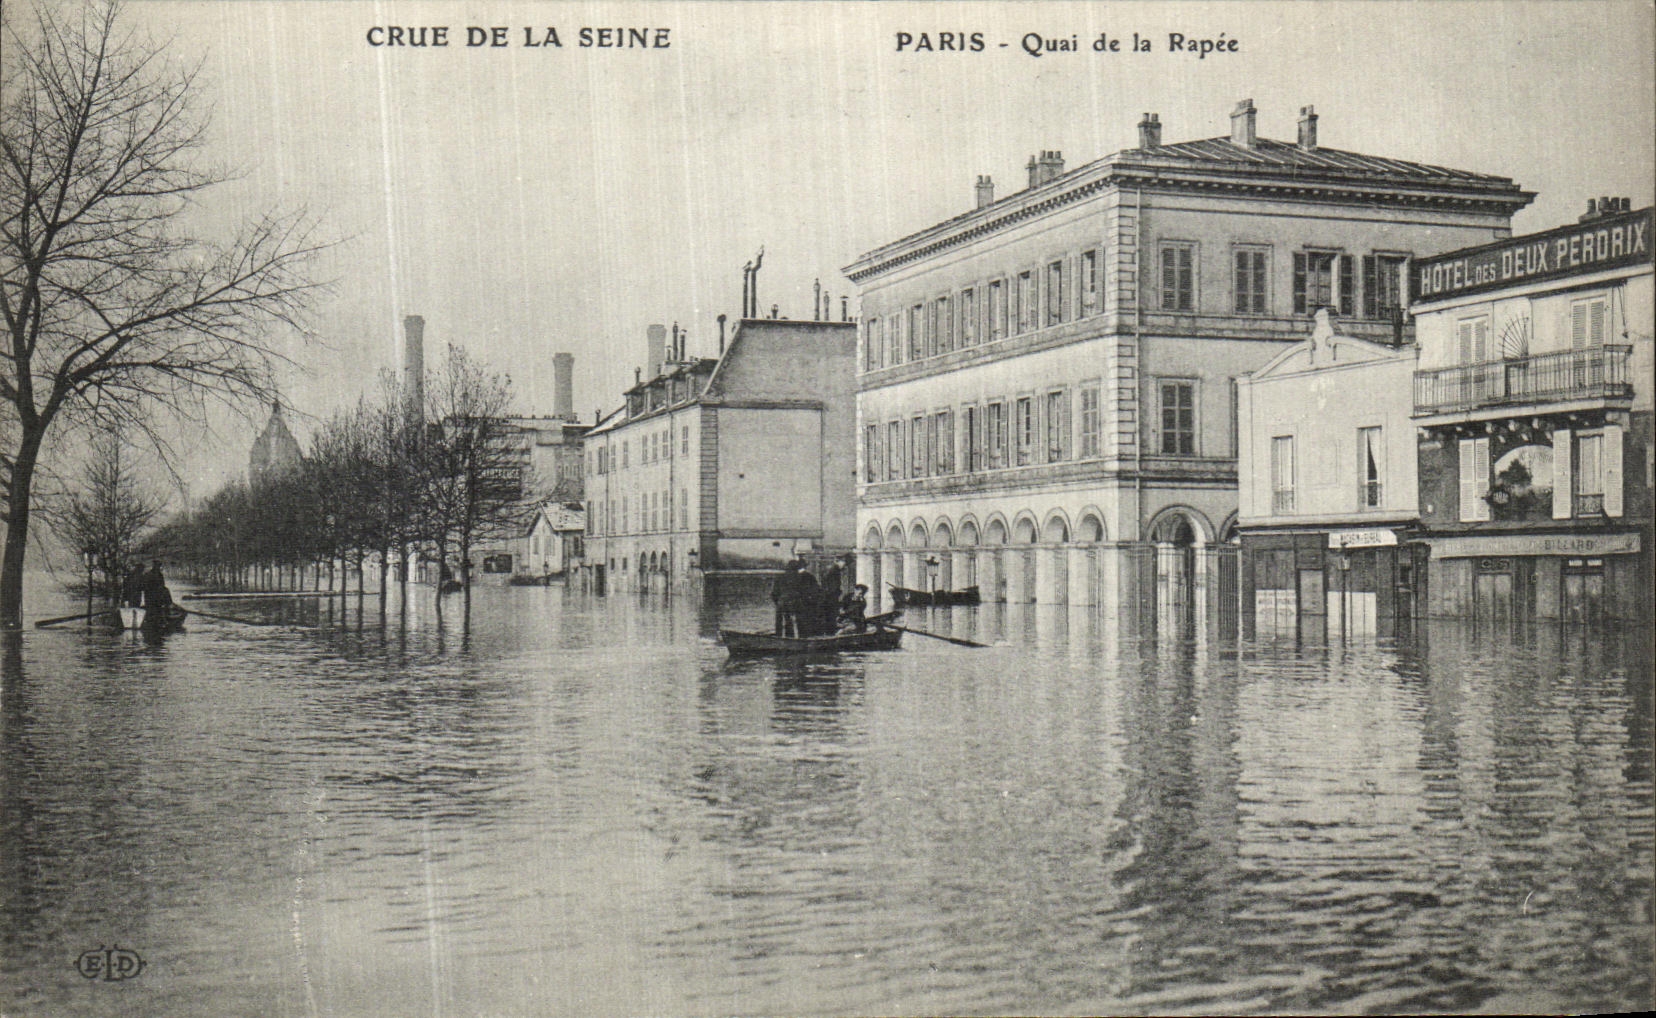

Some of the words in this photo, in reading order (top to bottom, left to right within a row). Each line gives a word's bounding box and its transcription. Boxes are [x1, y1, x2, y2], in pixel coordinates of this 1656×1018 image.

[1475, 263, 1497, 285] DES
[1501, 240, 1549, 280] DEUX
[1555, 221, 1646, 269] PERDRIX
